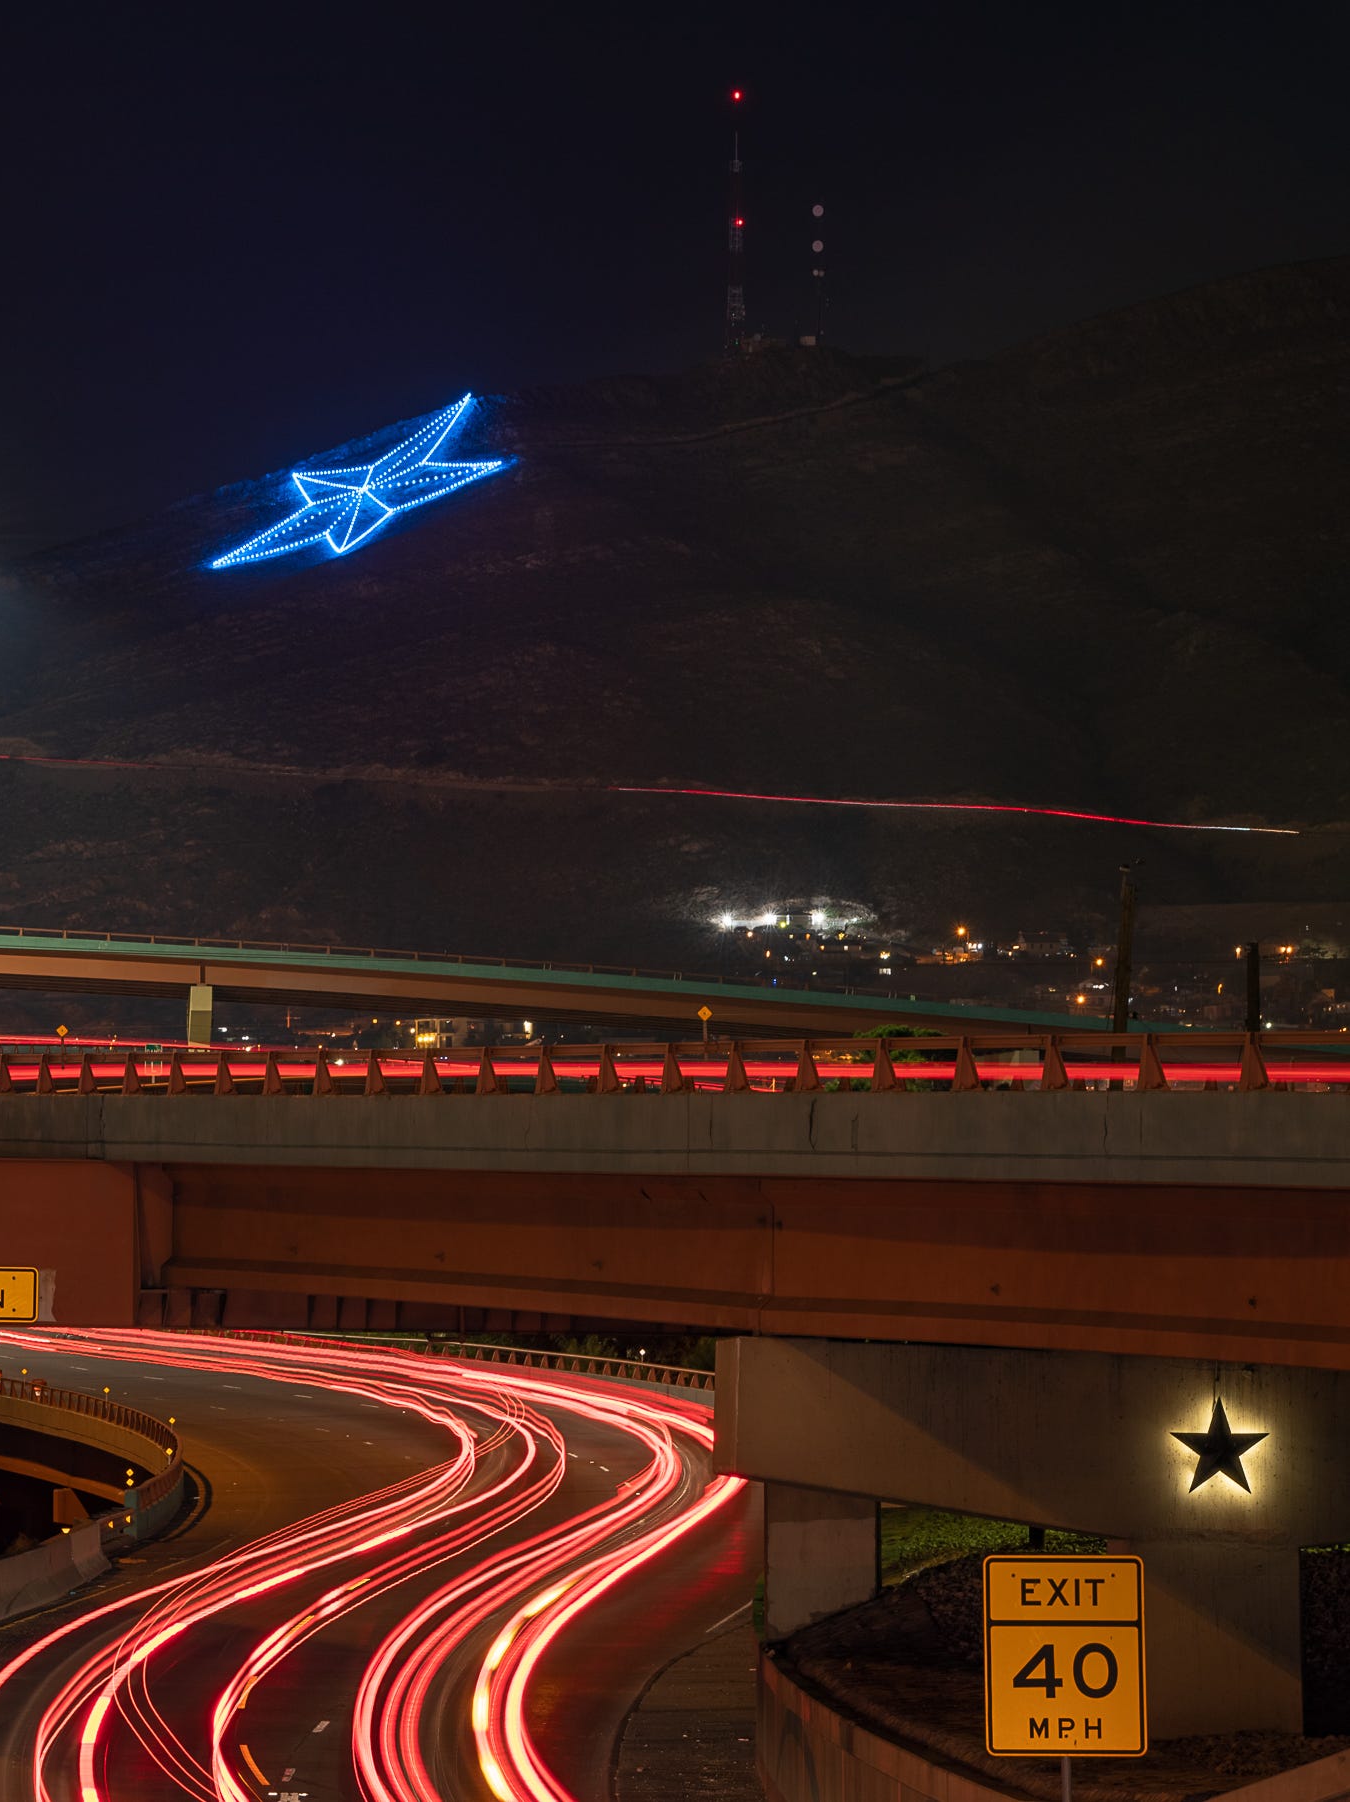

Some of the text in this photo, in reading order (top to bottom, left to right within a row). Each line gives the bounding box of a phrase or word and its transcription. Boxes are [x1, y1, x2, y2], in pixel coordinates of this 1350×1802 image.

[1020, 1578, 1105, 1607] EXIT
[1012, 1642, 1119, 1699] 40
[1029, 1717, 1102, 1739] MPH
